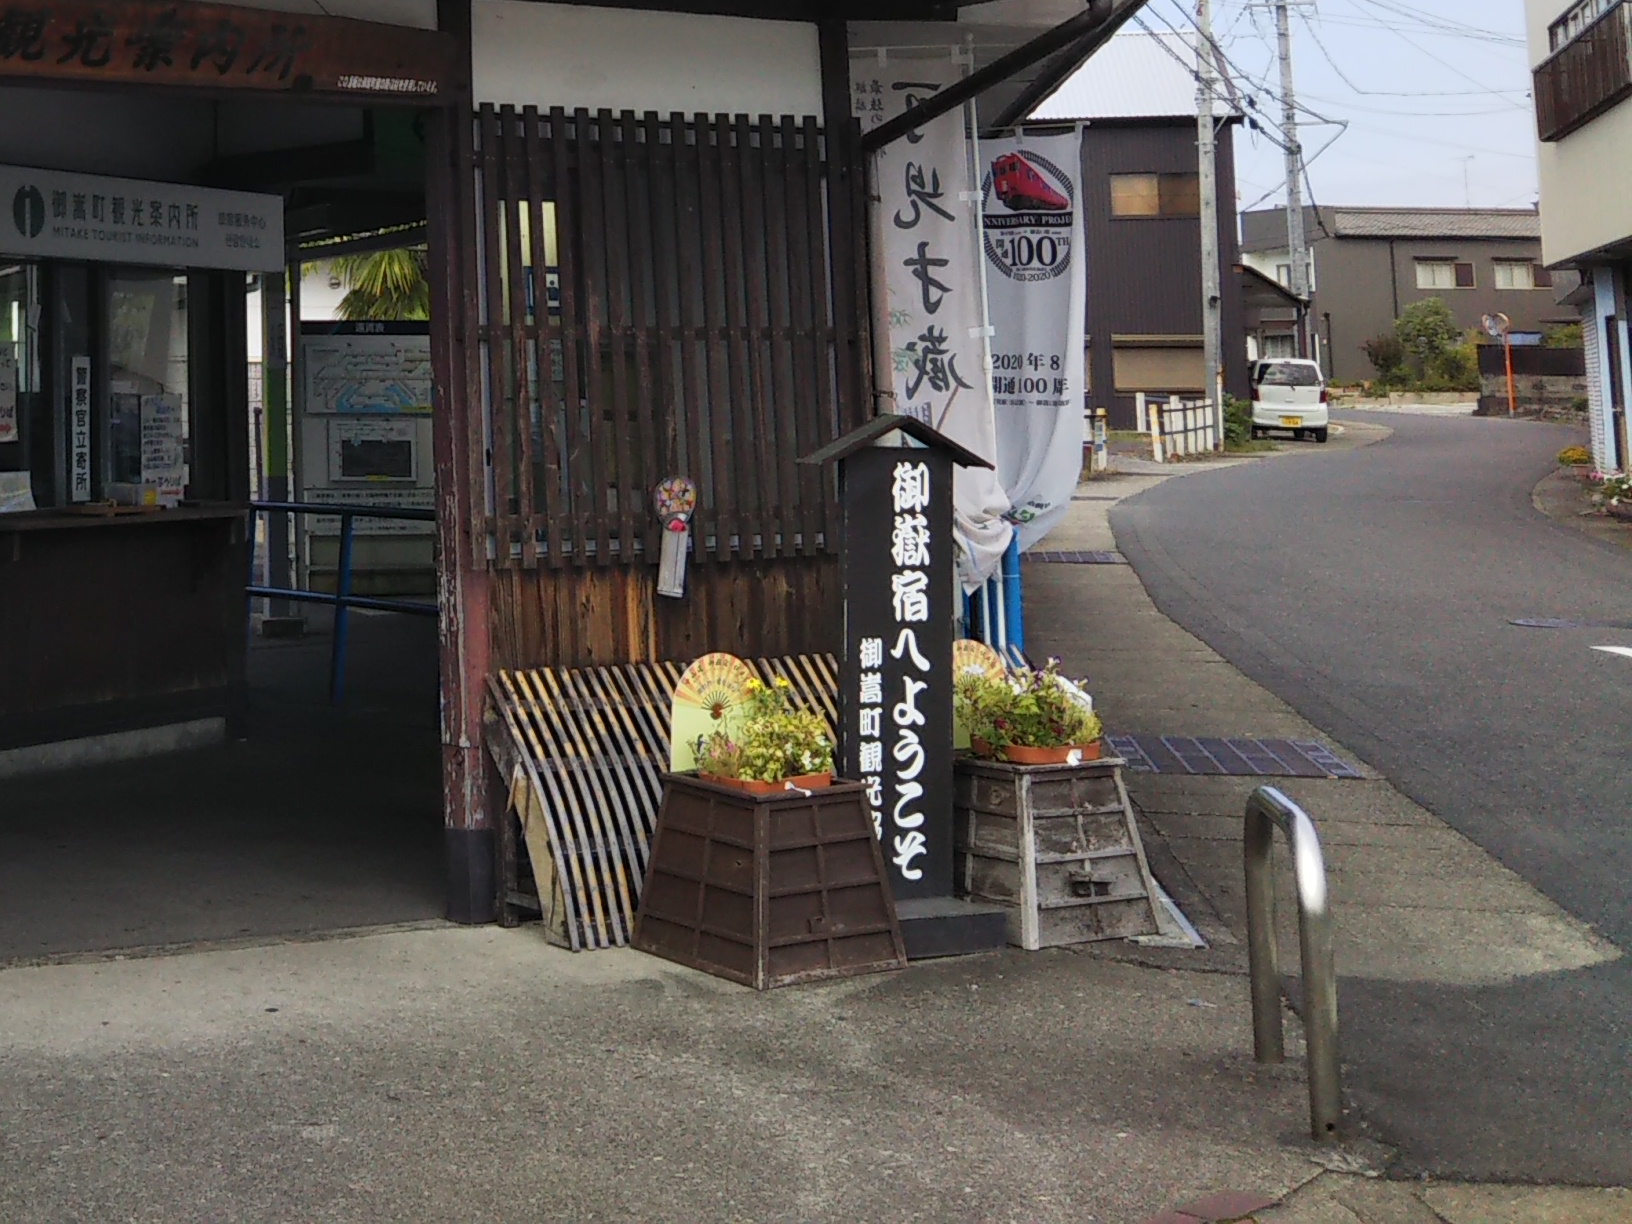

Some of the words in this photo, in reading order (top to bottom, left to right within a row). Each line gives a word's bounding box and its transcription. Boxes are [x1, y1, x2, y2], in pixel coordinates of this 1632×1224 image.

[52, 189, 199, 231] 御嵩町観光案内所
[982, 214, 1036, 226] NNIVERSARY
[53, 227, 89, 240] MITAKE
[92, 229, 133, 243] TOURIST
[135, 233, 200, 248] INFORMATION
[75, 367, 88, 492] 警察官立寄所
[890, 461, 931, 882] 御嶽宿へようこそ
